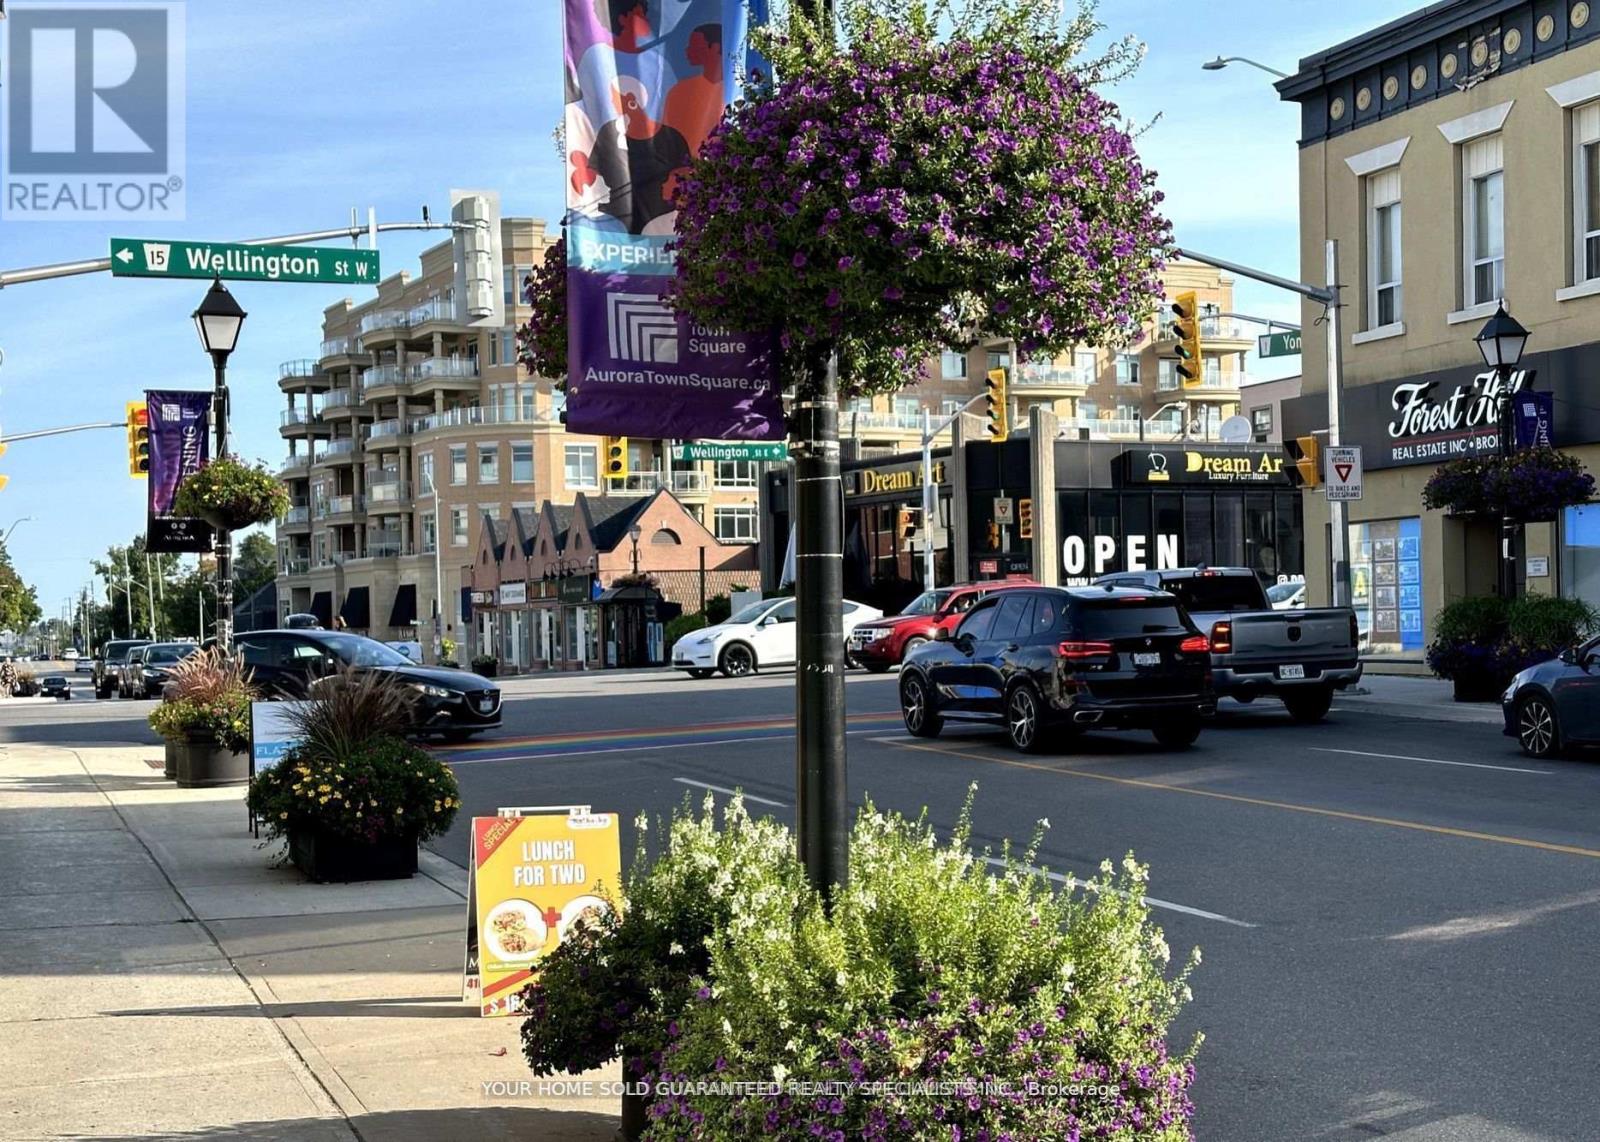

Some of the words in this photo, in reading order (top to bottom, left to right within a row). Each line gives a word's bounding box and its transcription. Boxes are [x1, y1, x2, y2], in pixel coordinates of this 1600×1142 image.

[150, 251, 165, 266] 15
[186, 248, 319, 279] Wellington
[335, 260, 349, 276] St
[356, 262, 368, 276] W
[688, 339, 747, 356] Square
[584, 368, 771, 391] AuroraTownSquare.ca
[1388, 381, 1466, 438] Forest
[690, 447, 749, 460] Wellington
[1392, 447, 1414, 460] REAL
[1416, 442, 1447, 457] ESTATE
[1449, 439, 1467, 453] INC
[1185, 451, 1252, 473] Dream
[863, 469, 914, 494] Dream
[1208, 471, 1234, 482] Luxury
[1063, 534, 1178, 574] OPEN
[522, 839, 575, 862] LUNCH
[513, 865, 545, 887] FOR
[550, 863, 586, 885] TWO
